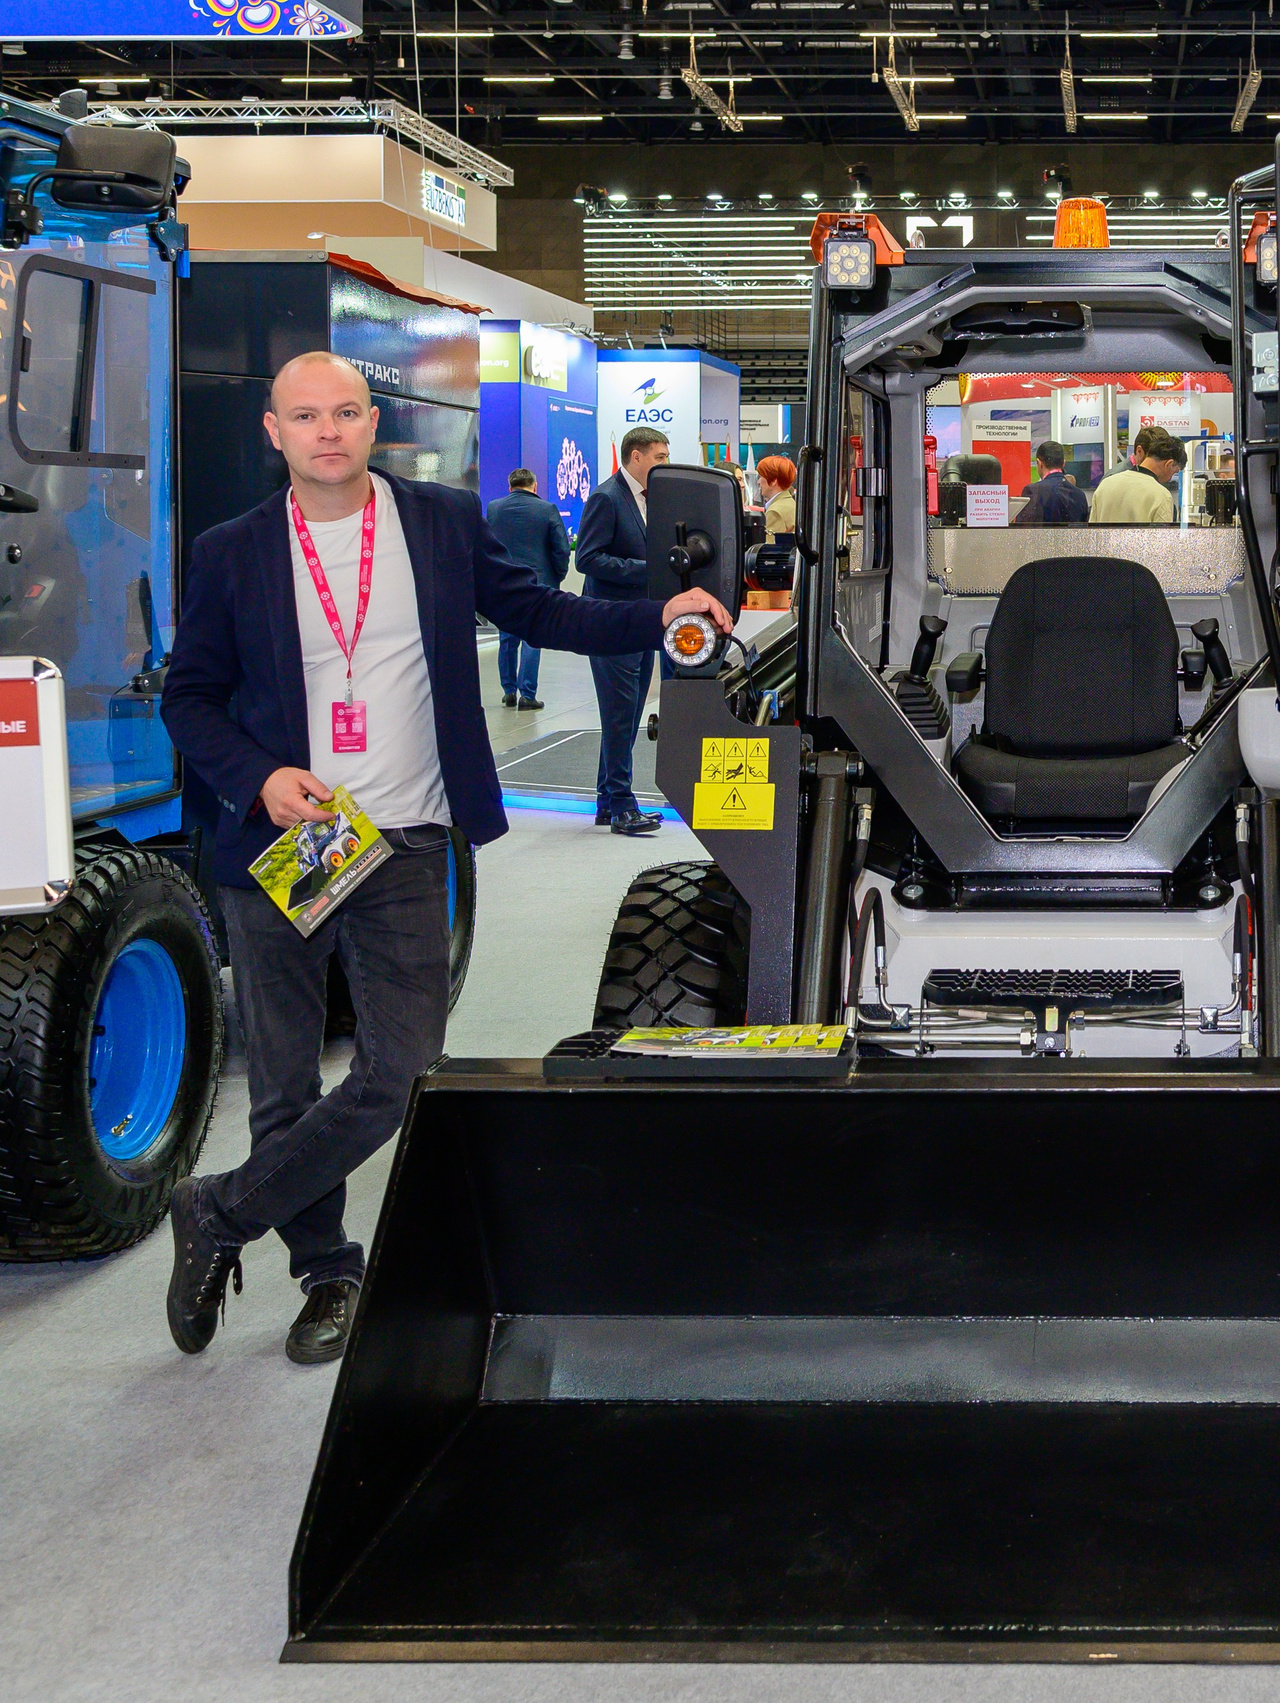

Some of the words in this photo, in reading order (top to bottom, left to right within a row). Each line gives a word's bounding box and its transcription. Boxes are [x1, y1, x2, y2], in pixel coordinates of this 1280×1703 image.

[342, 357, 400, 384] ТРАКС
[626, 409, 673, 422] ЕАЭС
[0, 721, 27, 733] ЫЕ
[330, 868, 357, 896] ШМЕЛЬ
